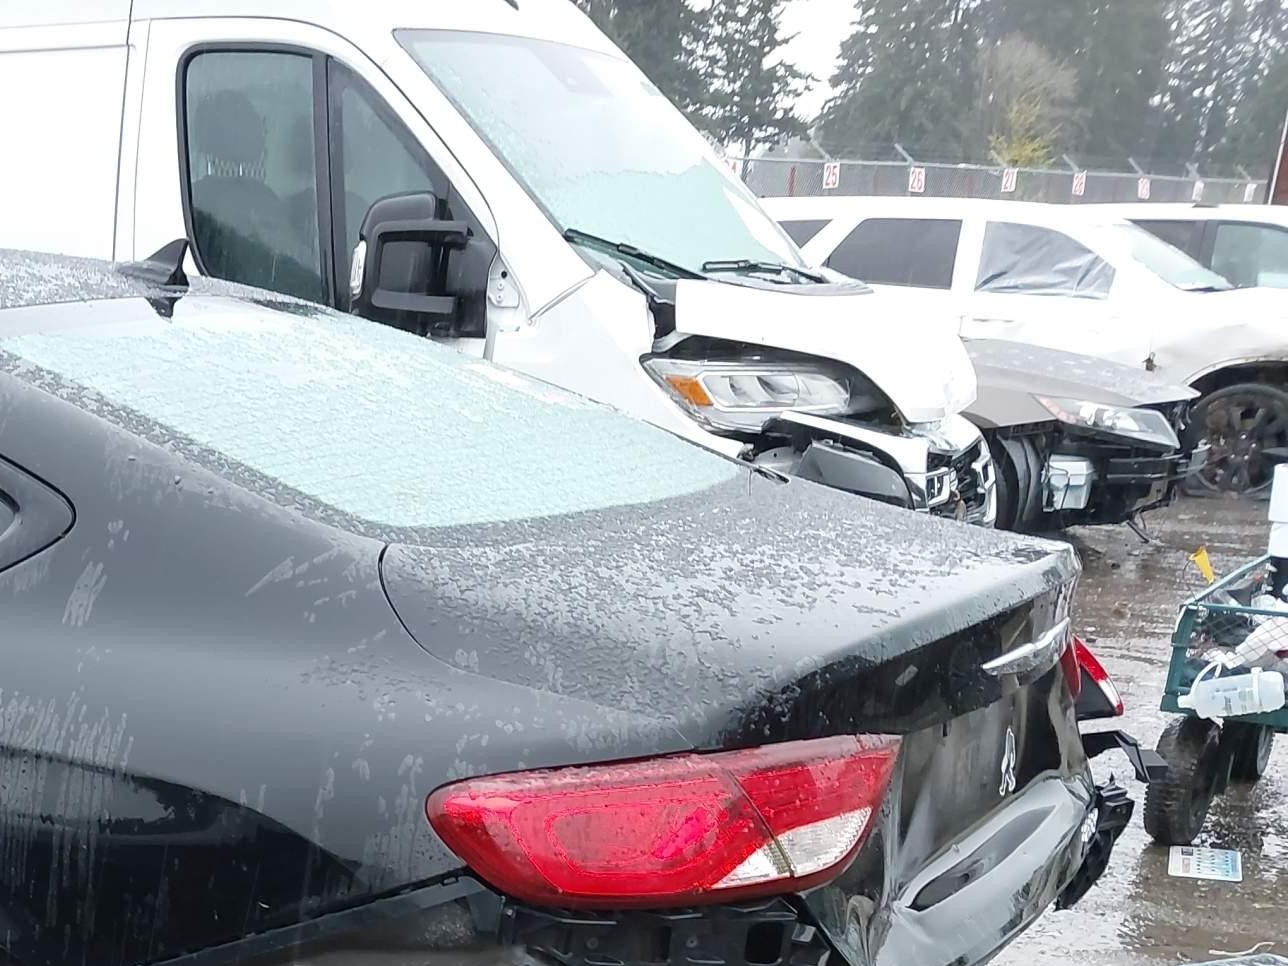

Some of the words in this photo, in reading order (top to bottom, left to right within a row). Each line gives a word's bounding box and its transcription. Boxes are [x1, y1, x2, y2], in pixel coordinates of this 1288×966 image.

[825, 165, 839, 187] 25
[910, 168, 924, 191] 26
[1002, 169, 1016, 191] 27
